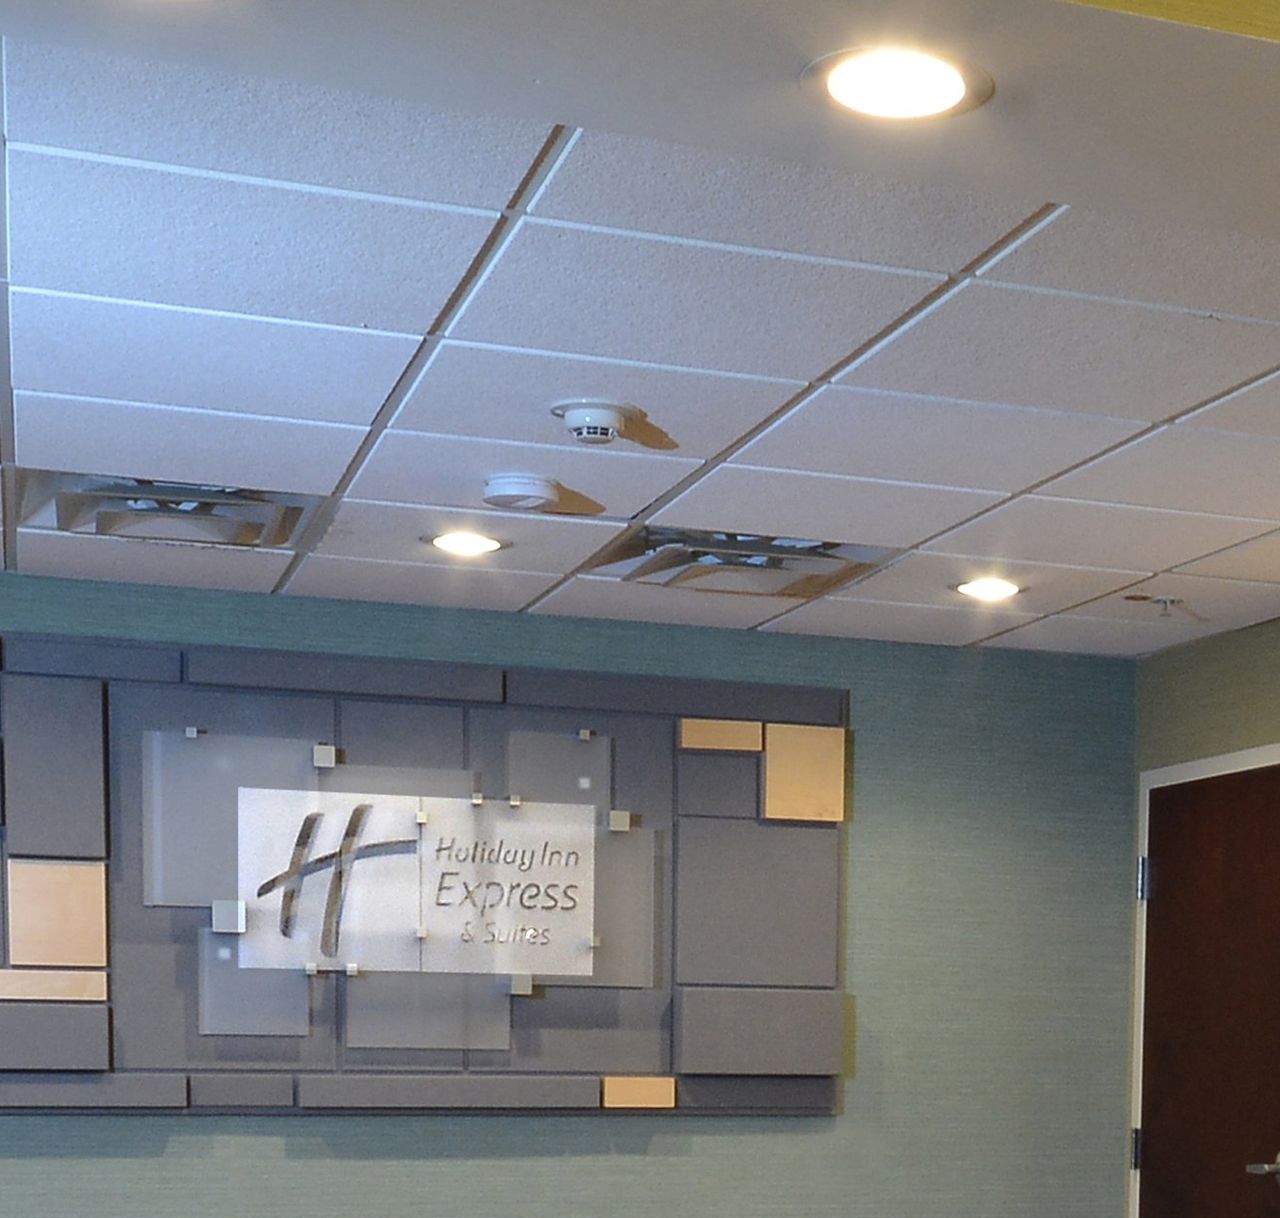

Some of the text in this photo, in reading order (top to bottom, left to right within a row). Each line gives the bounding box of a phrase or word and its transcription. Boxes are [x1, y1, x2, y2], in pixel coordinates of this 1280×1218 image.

[435, 838, 580, 872] Holiday Inn
[435, 871, 579, 917] Express
[461, 921, 551, 945] & Suites
